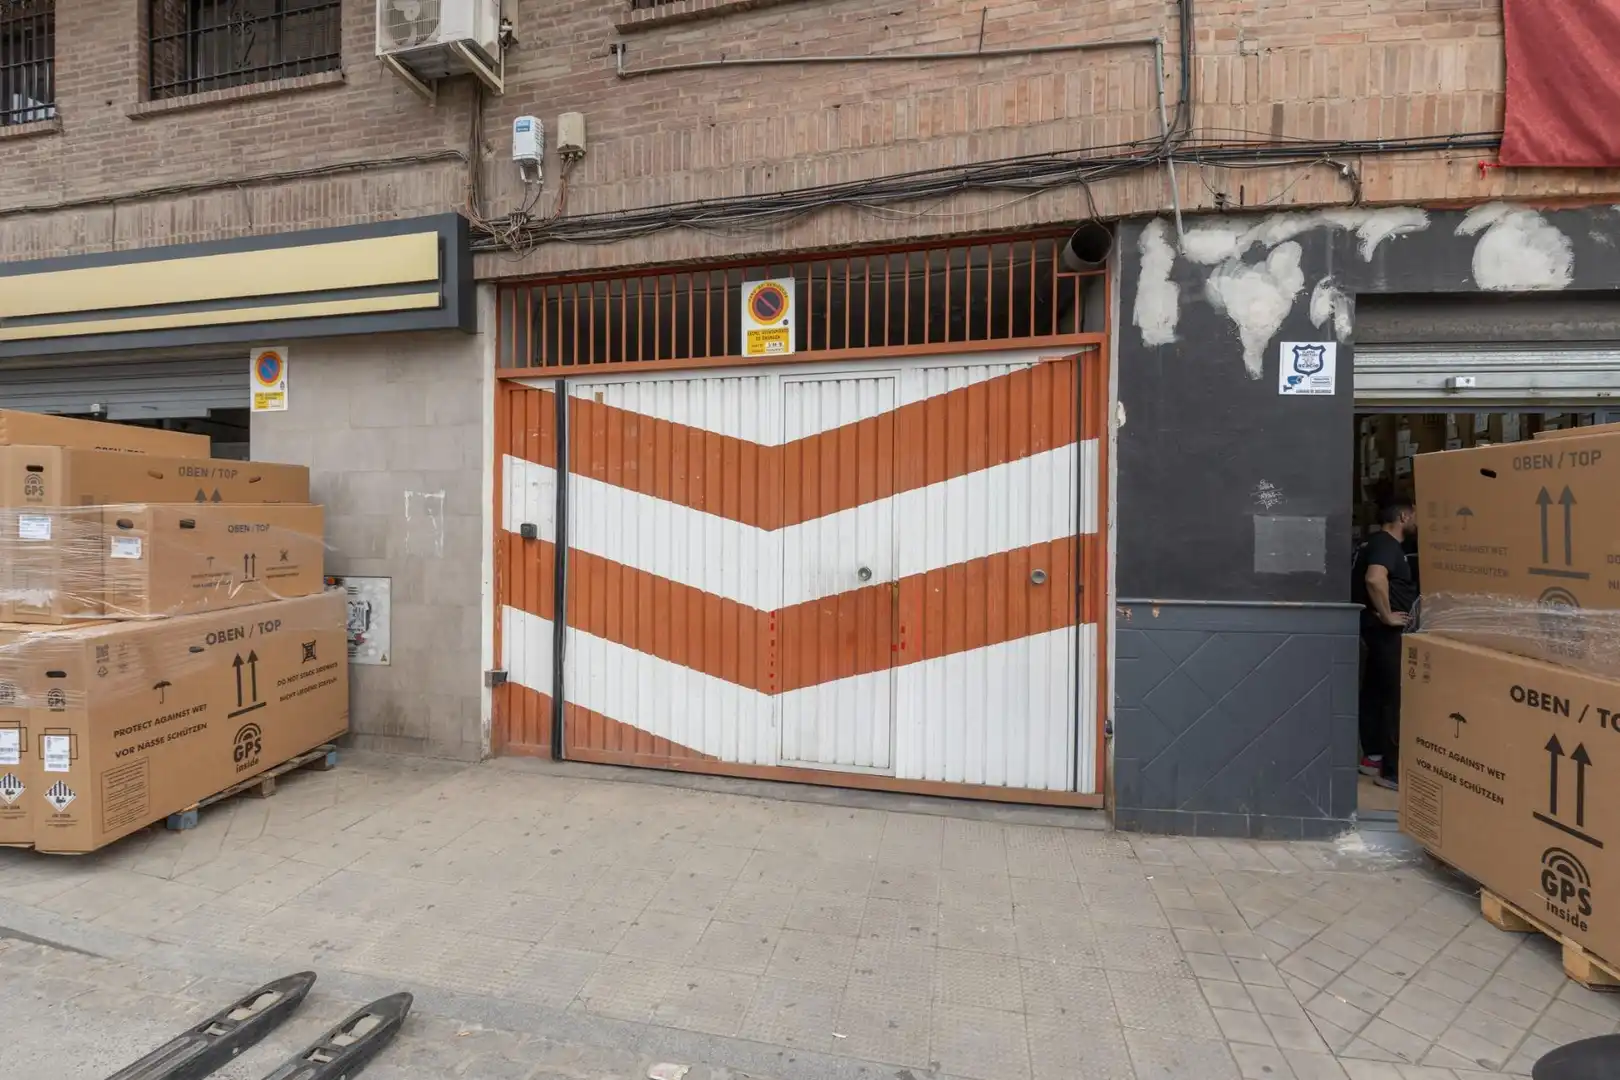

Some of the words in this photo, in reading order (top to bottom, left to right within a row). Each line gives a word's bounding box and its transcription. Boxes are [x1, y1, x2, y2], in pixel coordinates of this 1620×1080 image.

[178, 466, 208, 477] OBEN
[211, 468, 216, 477] /
[218, 469, 238, 479] TOP
[1513, 454, 1553, 471] OBEN
[1557, 451, 1564, 469] /
[1567, 449, 1602, 467] TOP
[24, 485, 44, 496] GPS
[227, 524, 250, 533] OBEN
[255, 523, 270, 532] TOP
[205, 626, 245, 645] OBEN
[249, 624, 254, 638] /
[258, 619, 282, 635] TOP
[1509, 684, 1571, 718] OBEN
[1577, 703, 1591, 724] /
[113, 719, 153, 739] PROTECT
[154, 708, 192, 727] AGAINST
[191, 703, 208, 714] WET
[115, 746, 136, 759] VOR
[233, 737, 262, 763] GPS
[1416, 736, 1447, 756] PROTECT
[1448, 751, 1486, 773] AGAINST
[1486, 766, 1506, 781] WET
[1416, 757, 1432, 770] VOR
[1541, 869, 1592, 917] GPS
[1546, 897, 1588, 932] inside
